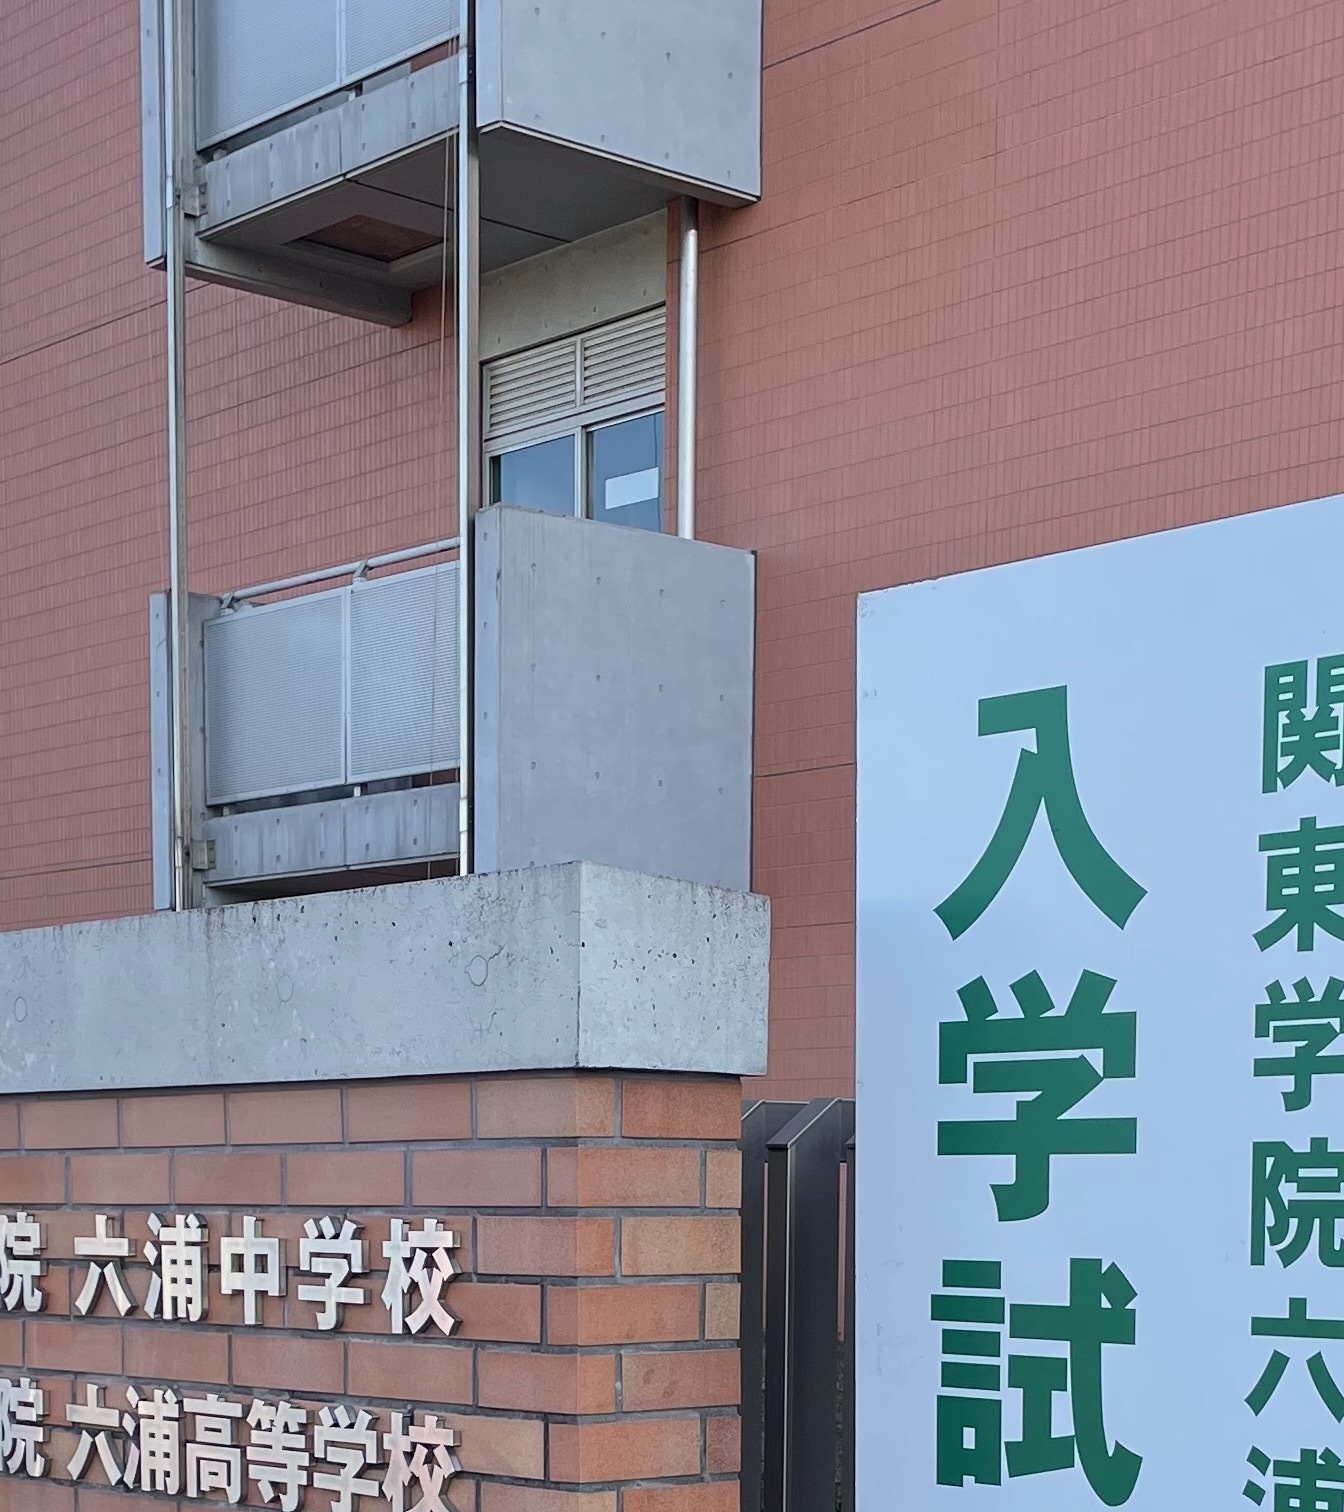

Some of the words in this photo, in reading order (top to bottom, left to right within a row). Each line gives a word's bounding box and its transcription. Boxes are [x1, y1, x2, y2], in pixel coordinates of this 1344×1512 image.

[73, 1210, 463, 1337] 六浦中学校
